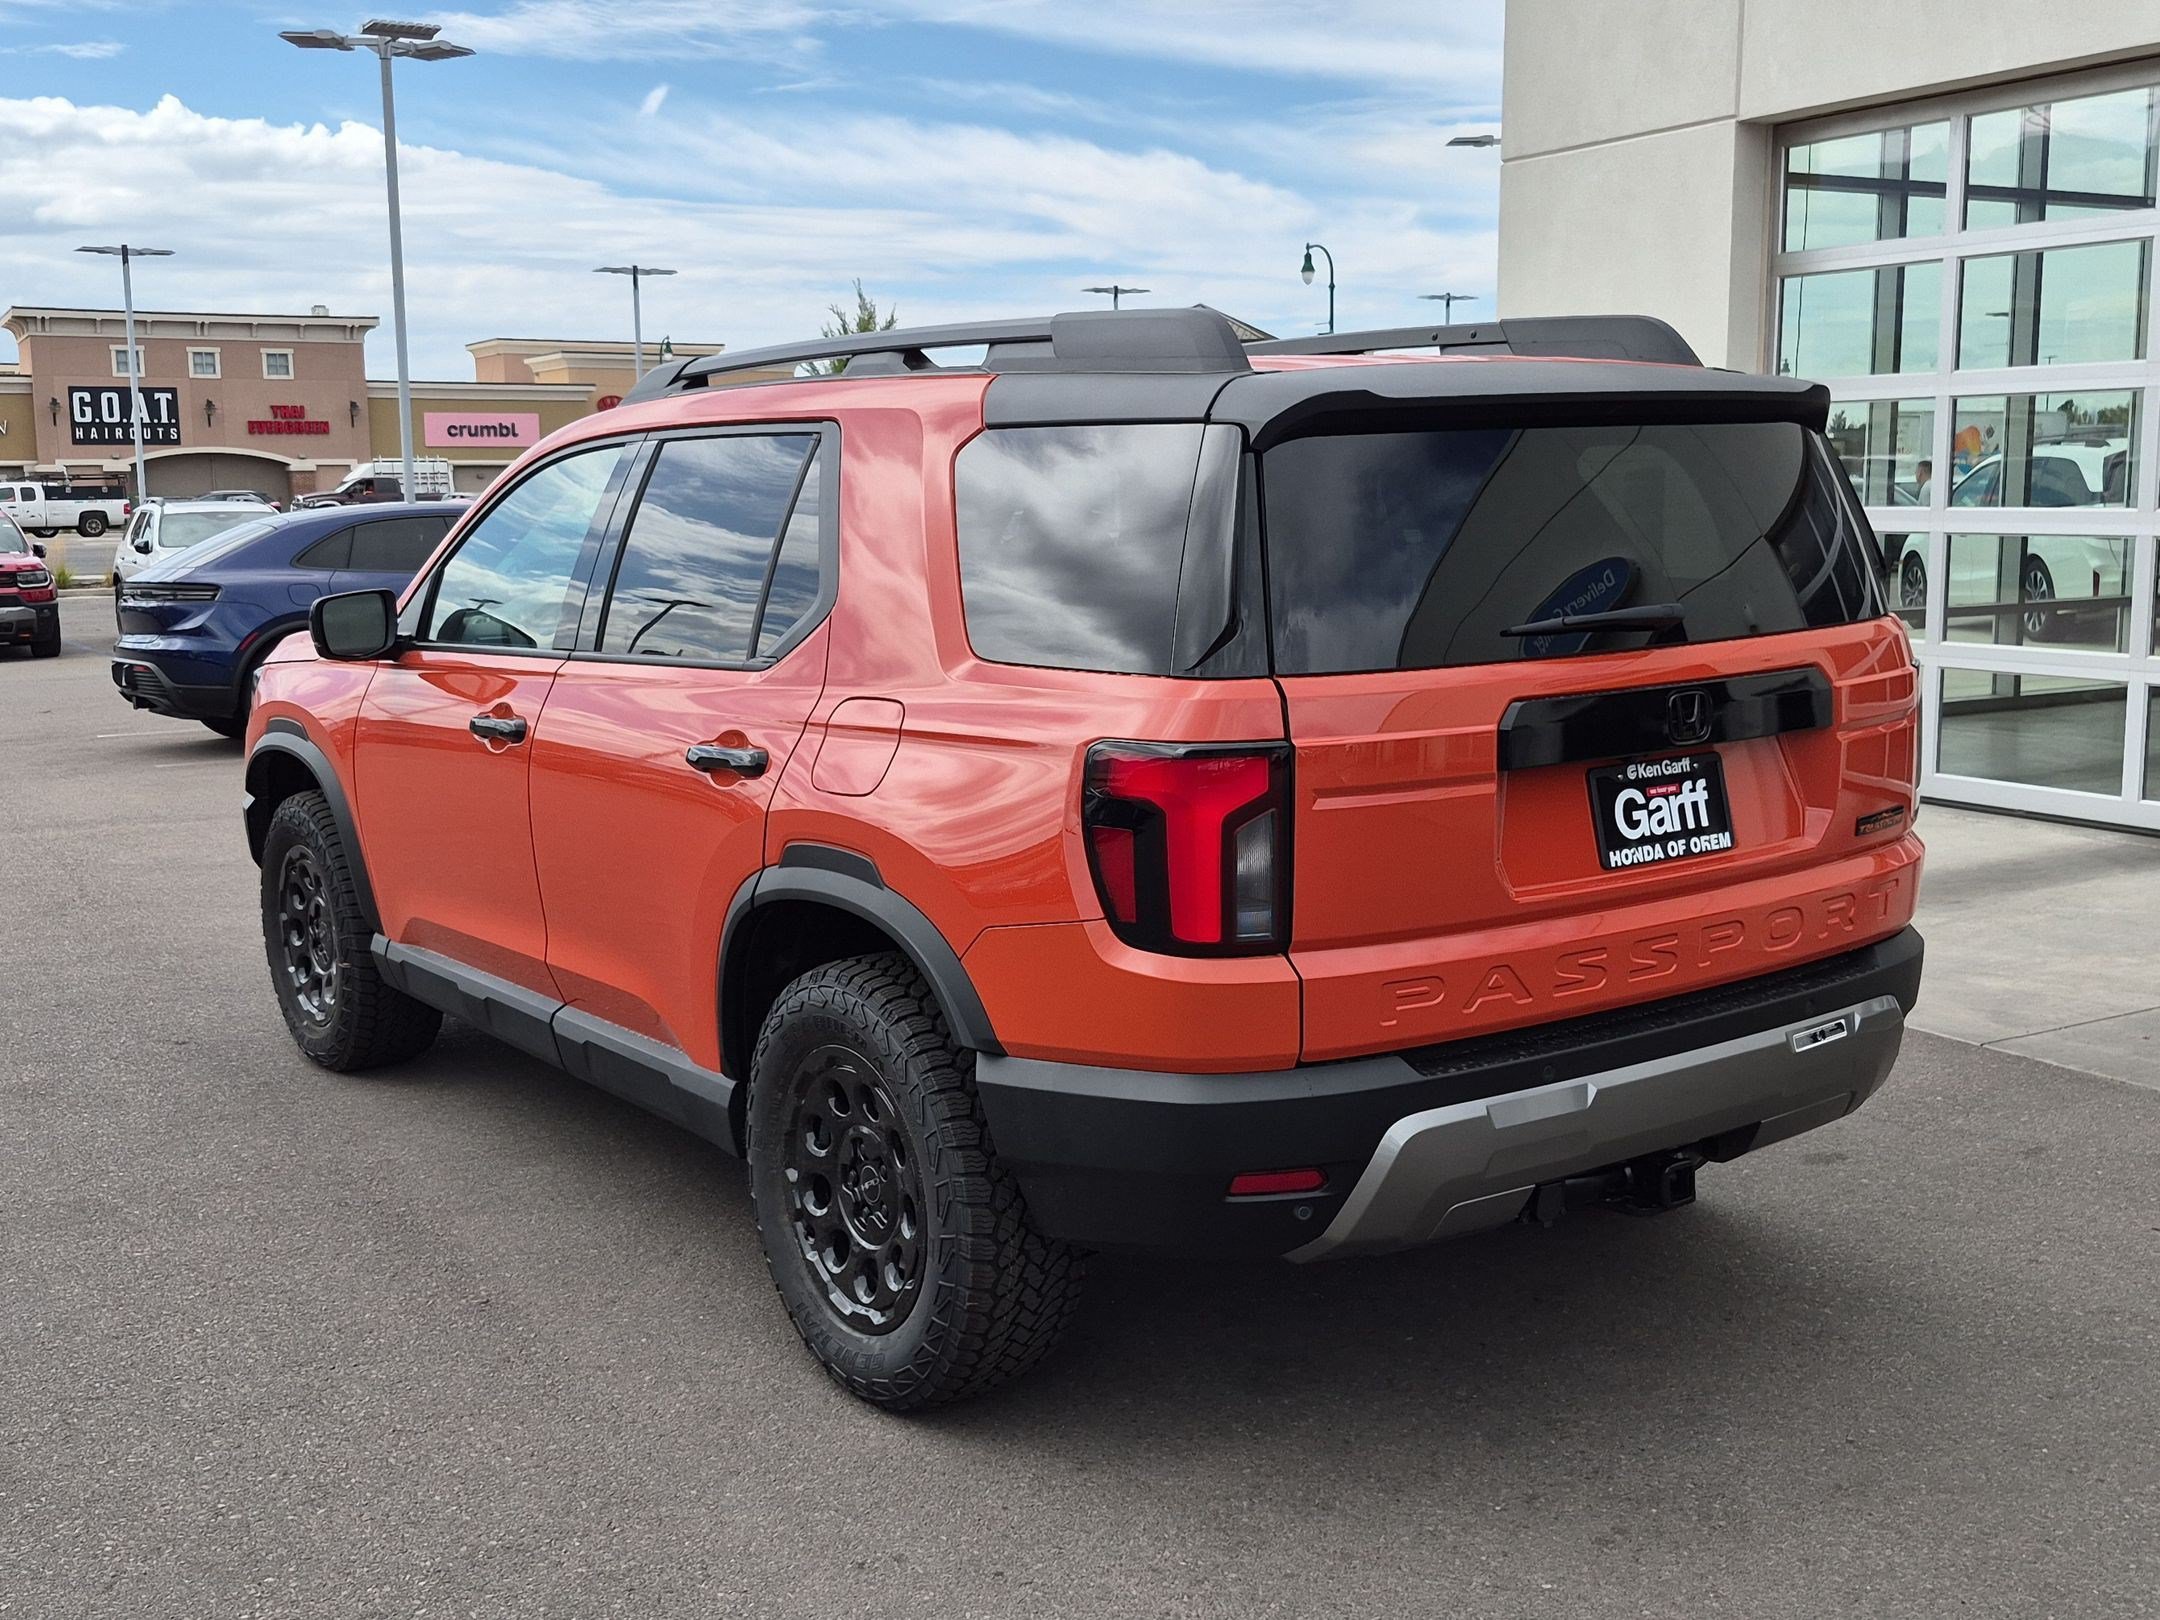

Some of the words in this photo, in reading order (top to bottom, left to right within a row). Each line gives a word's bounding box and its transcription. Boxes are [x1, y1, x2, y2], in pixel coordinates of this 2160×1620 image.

[72, 391, 176, 424] G.O.A.T.
[270, 405, 305, 420] THAI
[75, 427, 178, 440] HAIRCUTS
[247, 420, 330, 435] EVERGREEN
[446, 422, 519, 438] crumbl
[1661, 757, 1691, 775] Garff
[1614, 778, 1709, 840] Garff
[1609, 843, 1665, 867] HONDA
[1667, 839, 1687, 857] OF
[1690, 831, 1732, 854] OREM
[1379, 878, 1898, 1026] PASSPORT
